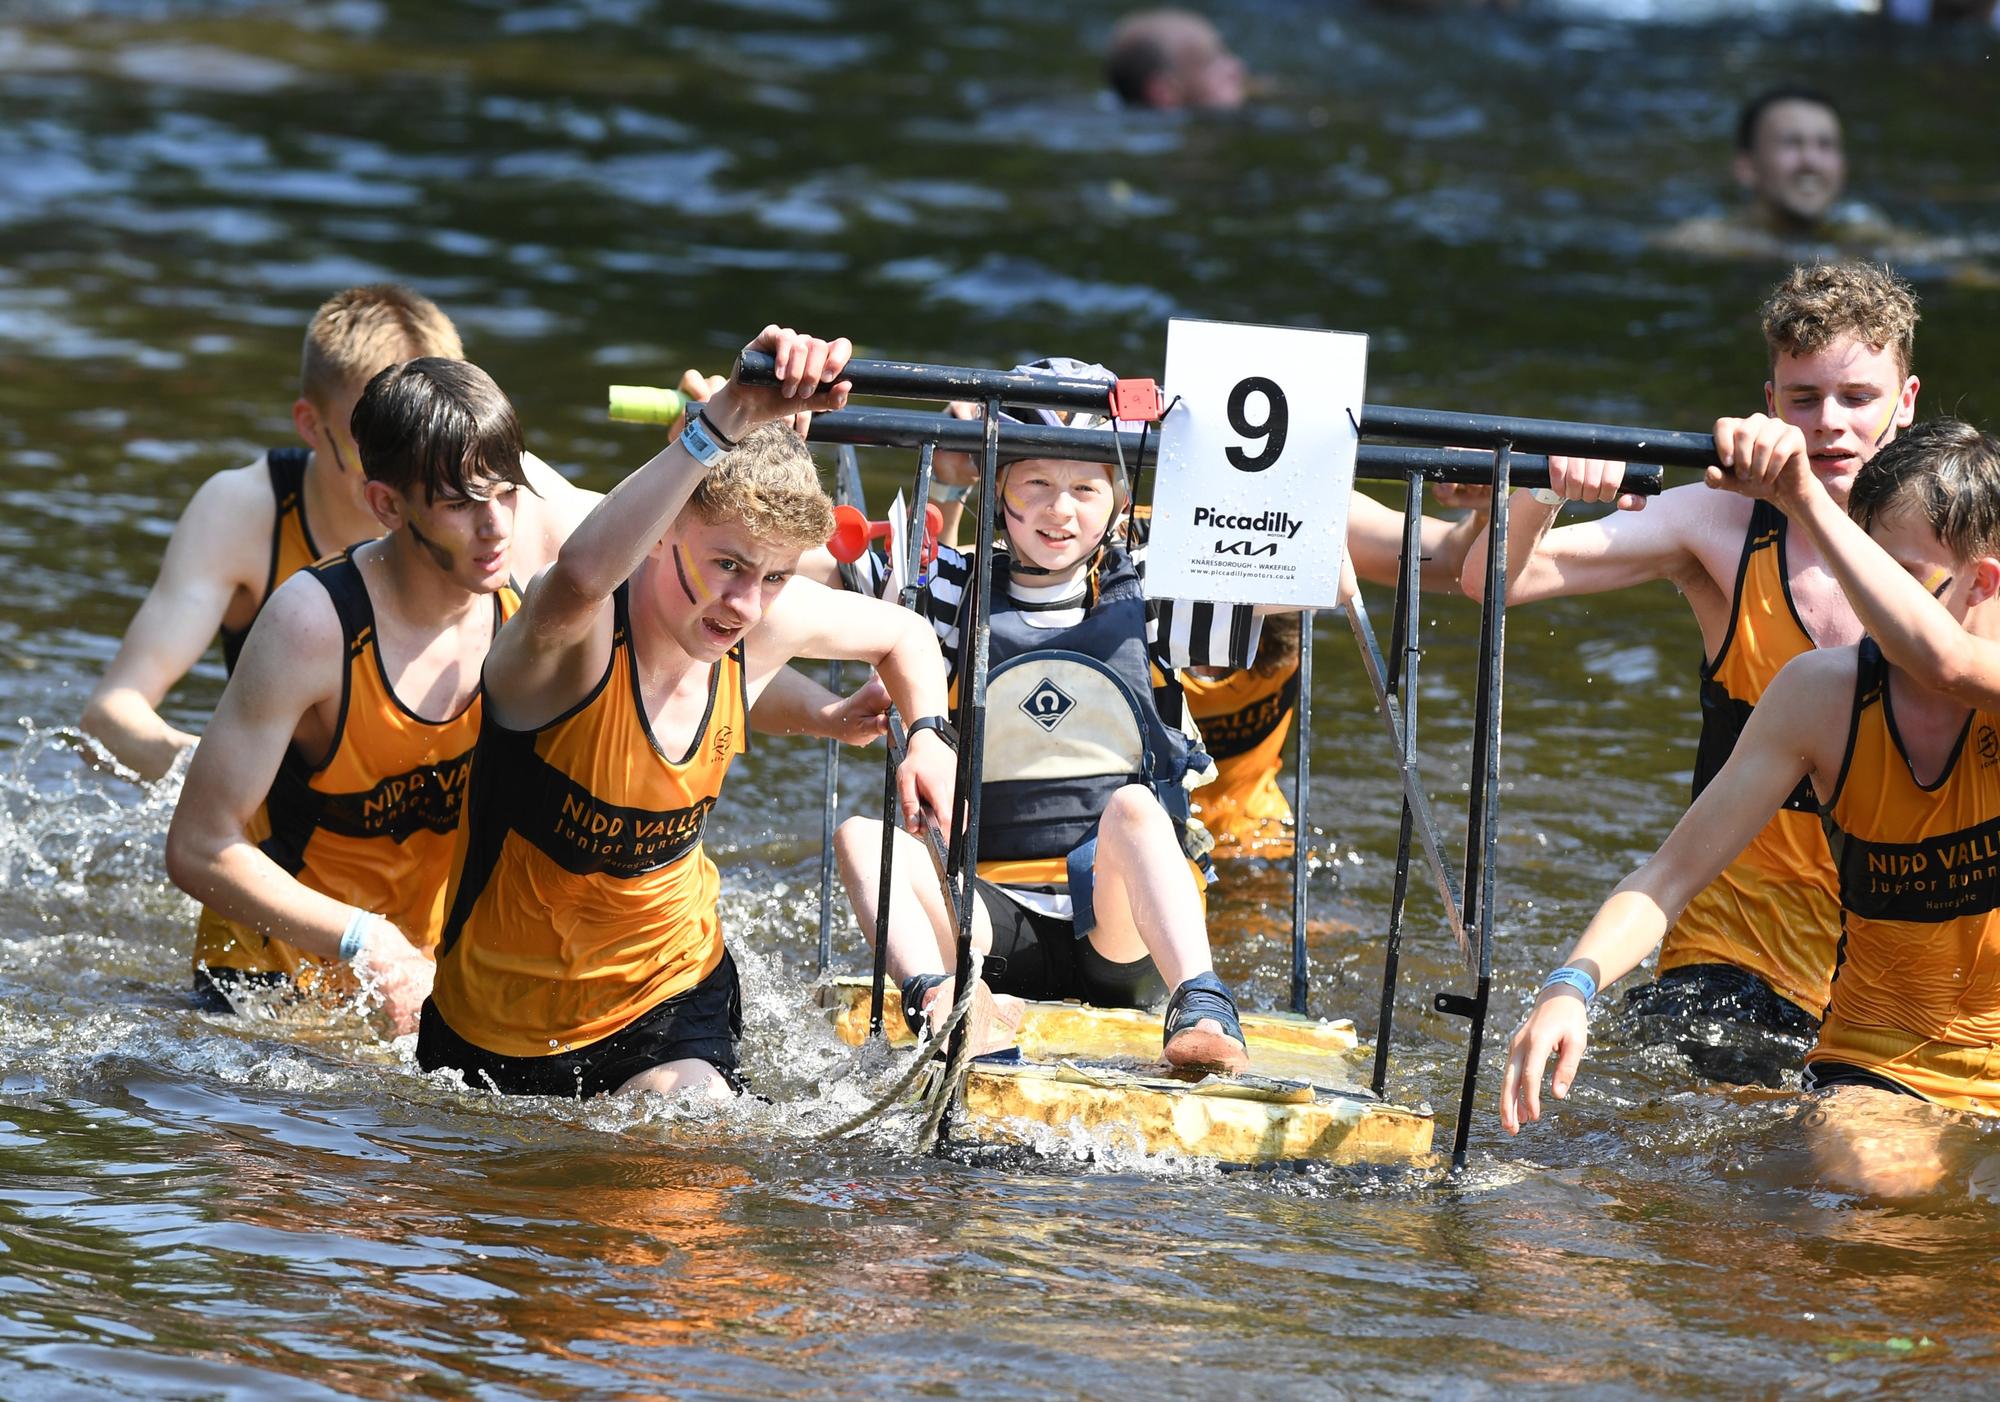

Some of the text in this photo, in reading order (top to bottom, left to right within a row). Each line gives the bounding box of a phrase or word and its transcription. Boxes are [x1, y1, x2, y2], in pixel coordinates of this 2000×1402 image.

[1225, 376, 1289, 473] 9
[1193, 506, 1303, 539] Piccadilly
[1214, 540, 1278, 557] KIA
[1190, 568, 1295, 580] www.piccadillymotors.co.uk
[1191, 559, 1252, 569] KNARESBOROUGH
[1258, 563, 1297, 572] WAKEFIELD
[364, 762, 470, 817] NIDD VA
[562, 793, 711, 838] NIDD VALLEY
[554, 819, 623, 854] Junior
[1868, 852, 1928, 876] NIDD
[1949, 866, 1997, 889] Runn
